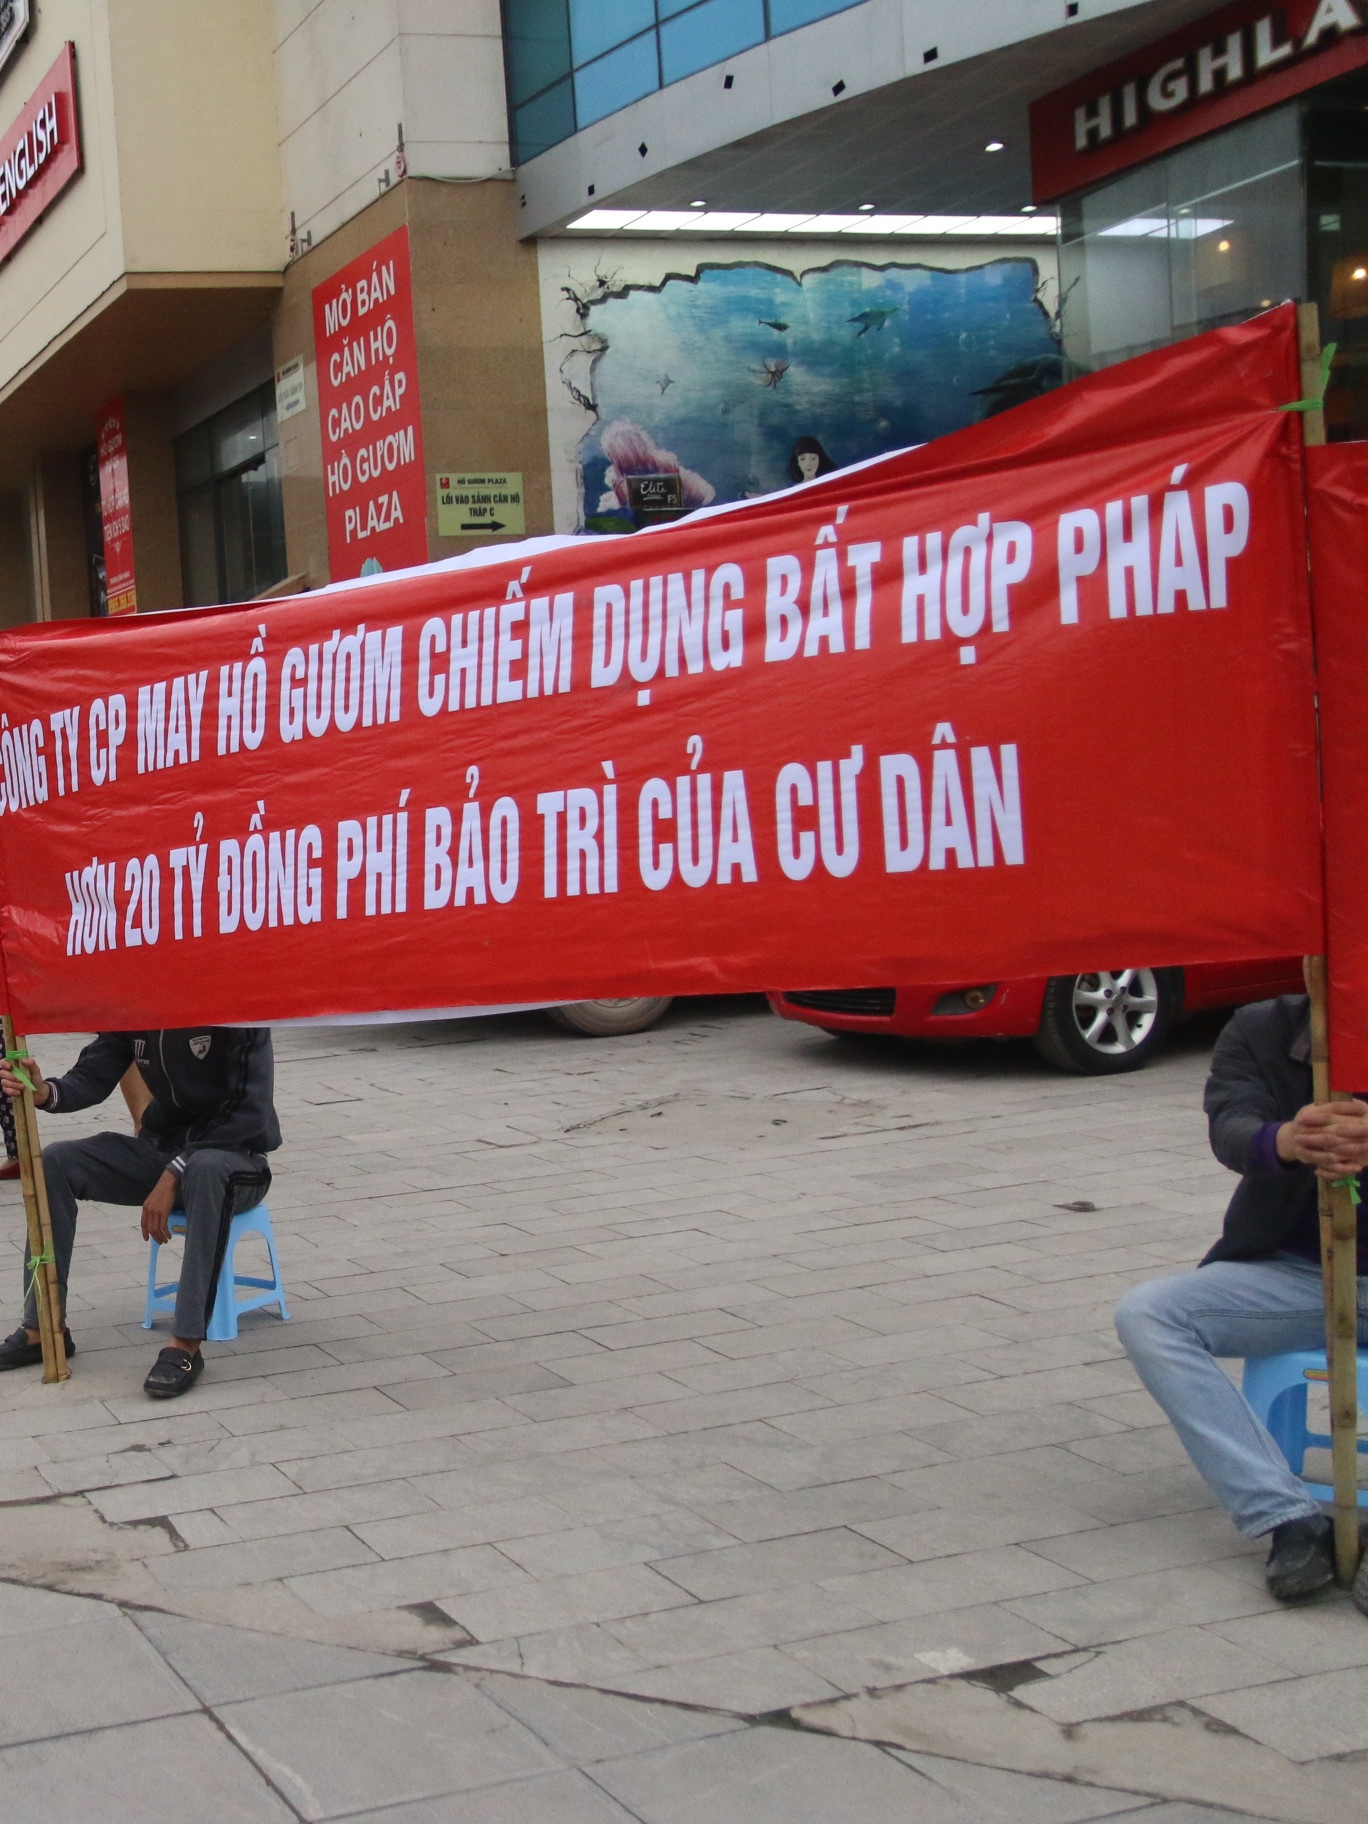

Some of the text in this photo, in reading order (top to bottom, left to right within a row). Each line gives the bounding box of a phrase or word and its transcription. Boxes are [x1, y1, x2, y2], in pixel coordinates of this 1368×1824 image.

[1074, 0, 1361, 152] HIGHLA
[324, 260, 396, 337] MỞ BÁN
[330, 314, 397, 387] CĂN HỘ
[327, 369, 406, 442] CAO CẤP
[327, 425, 415, 497] HỒ GƯƠM
[487, 477, 507, 485] PLAZA
[345, 490, 404, 543] PLAZA
[489, 507, 495, 517] C
[49, 705, 81, 796] TY
[88, 693, 127, 786] CP
[137, 670, 209, 774] MAY
[217, 623, 268, 756] HỒ
[279, 623, 404, 744] GƯƠM
[417, 567, 574, 718] CHIẾM
[590, 563, 745, 707] DỤNG
[764, 505, 882, 664] BẤT
[900, 512, 1033, 666] HỢP
[1056, 463, 1251, 626] PHÁP
[64, 722, 1026, 957] HƠN 20 TỶ ĐỒNG PHÍ BẢO TRÌ CỦA CƯ DÂN
